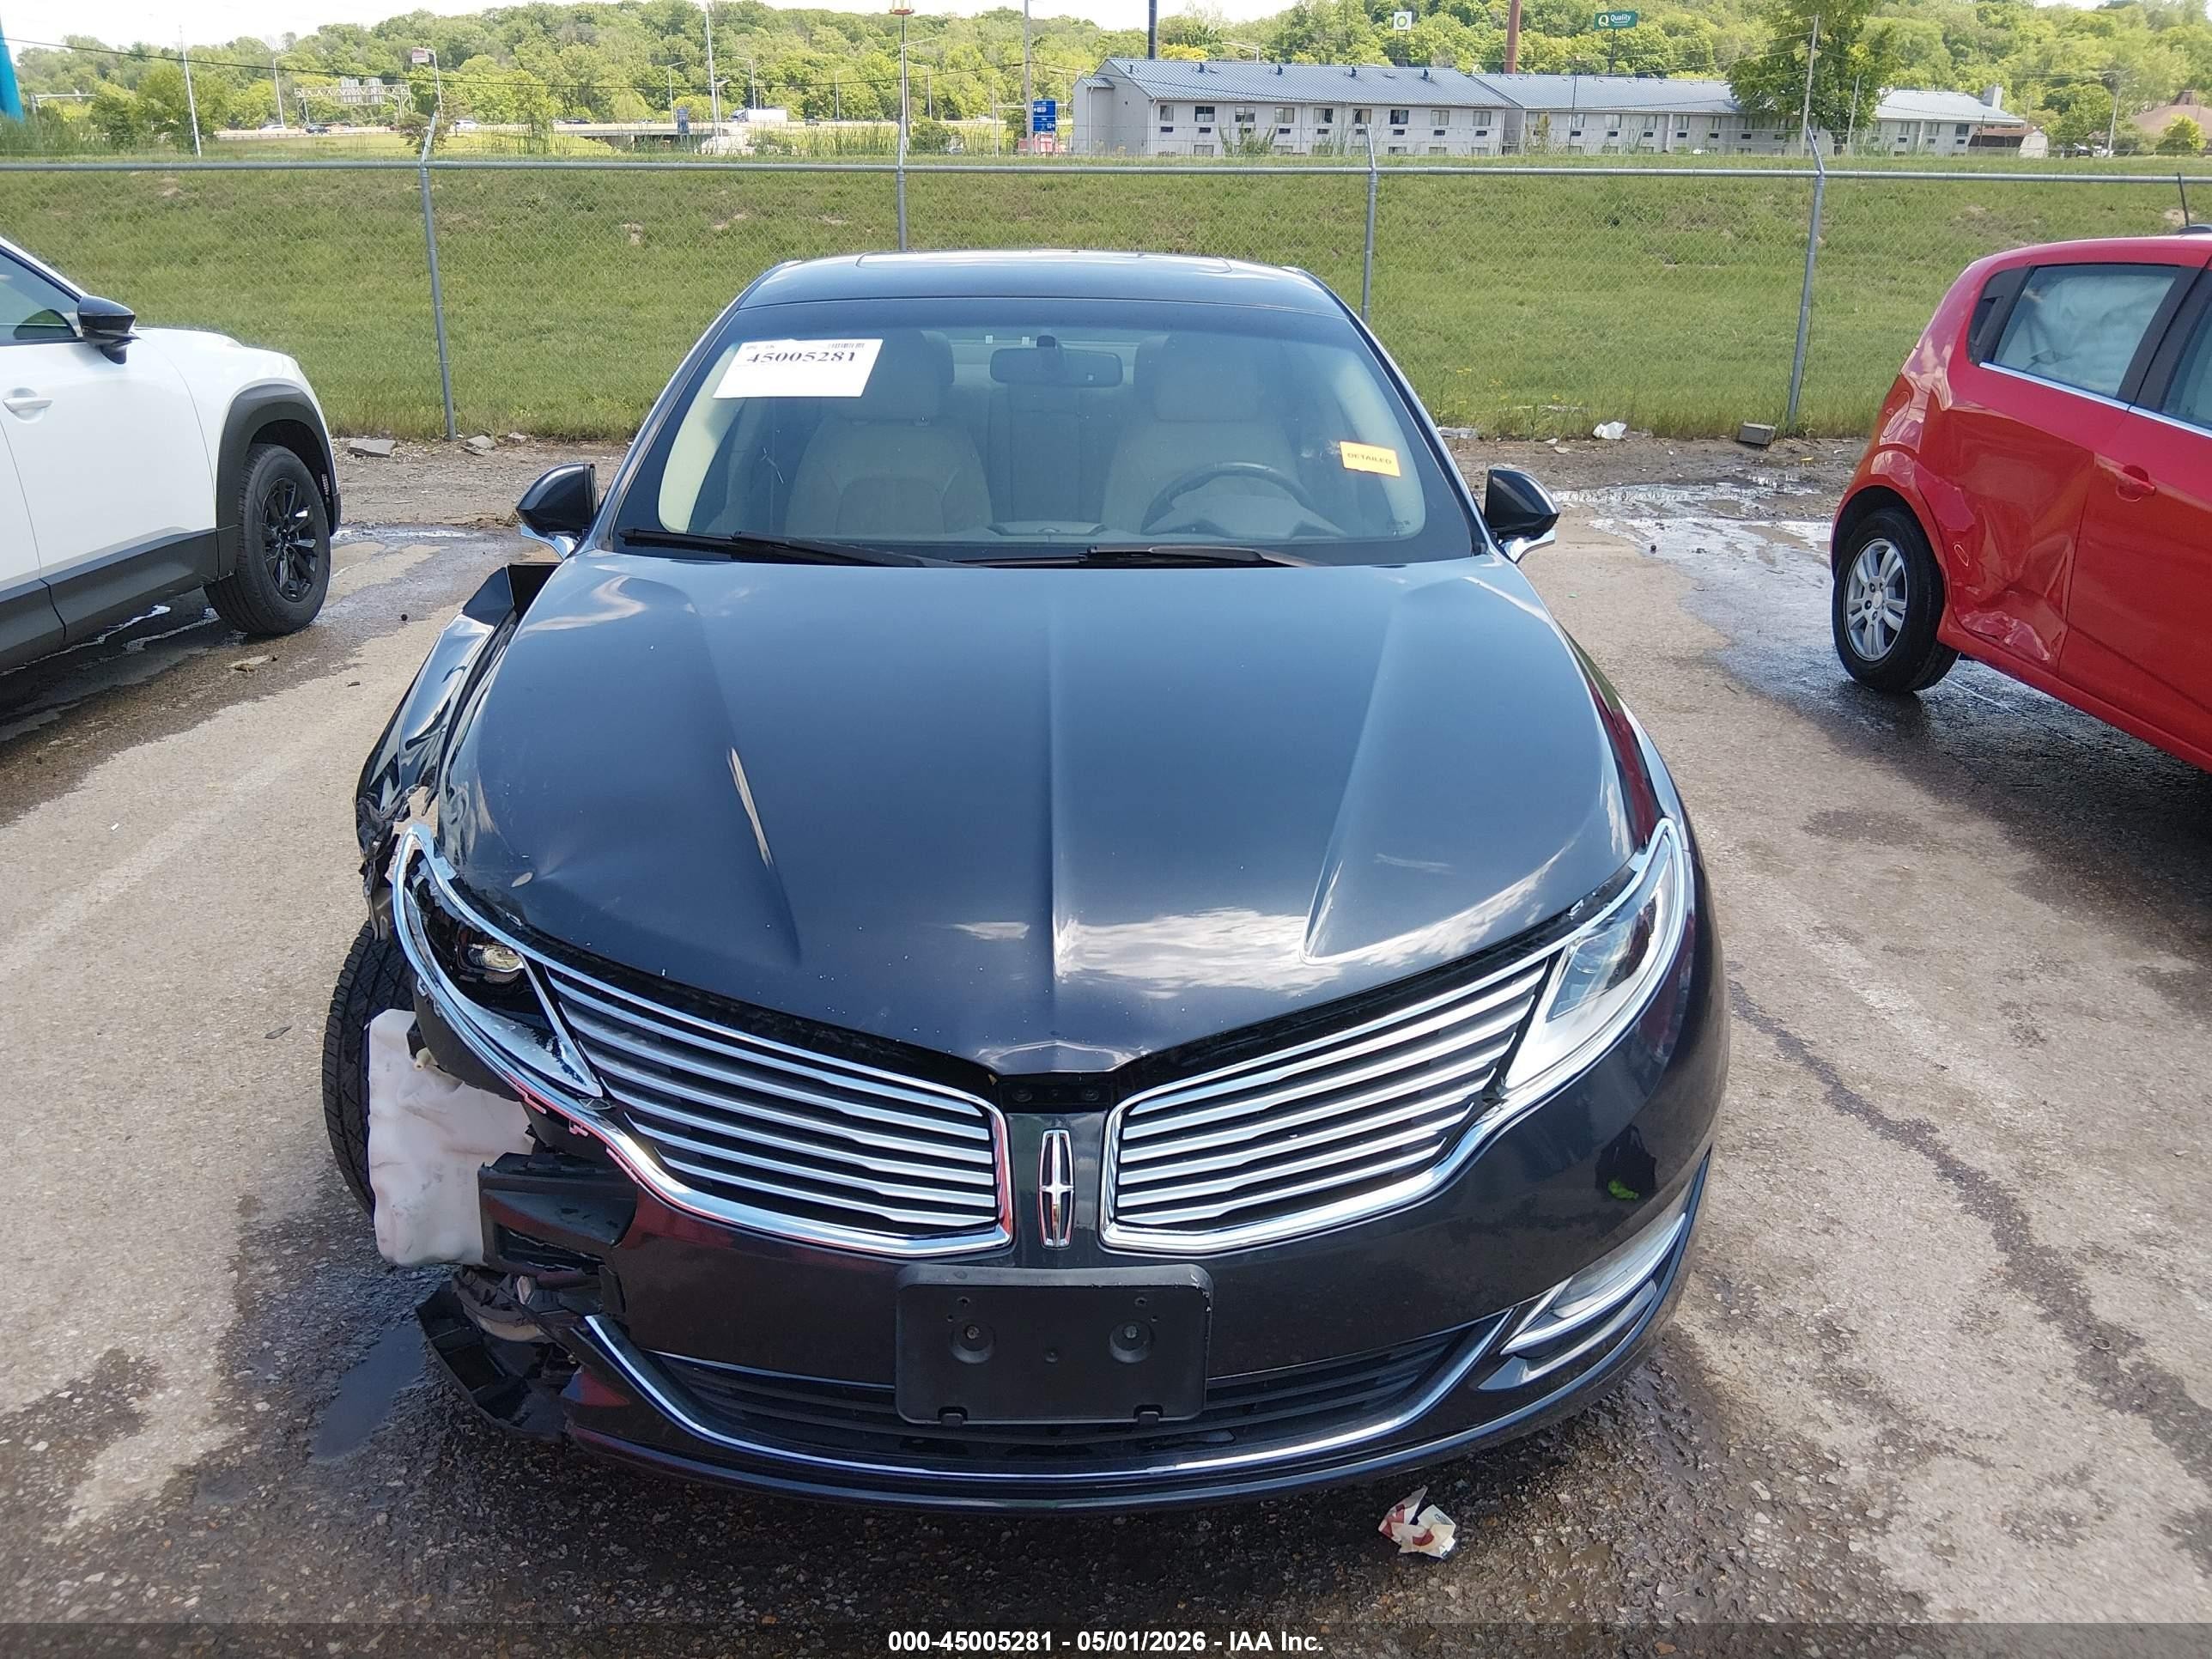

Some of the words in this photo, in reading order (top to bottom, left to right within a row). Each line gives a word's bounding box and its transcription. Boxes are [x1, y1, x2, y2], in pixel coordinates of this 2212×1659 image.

[1610, 14, 1632, 22] Quality
[746, 351, 855, 362] 45005281
[1346, 453, 1392, 465] DETAILED
